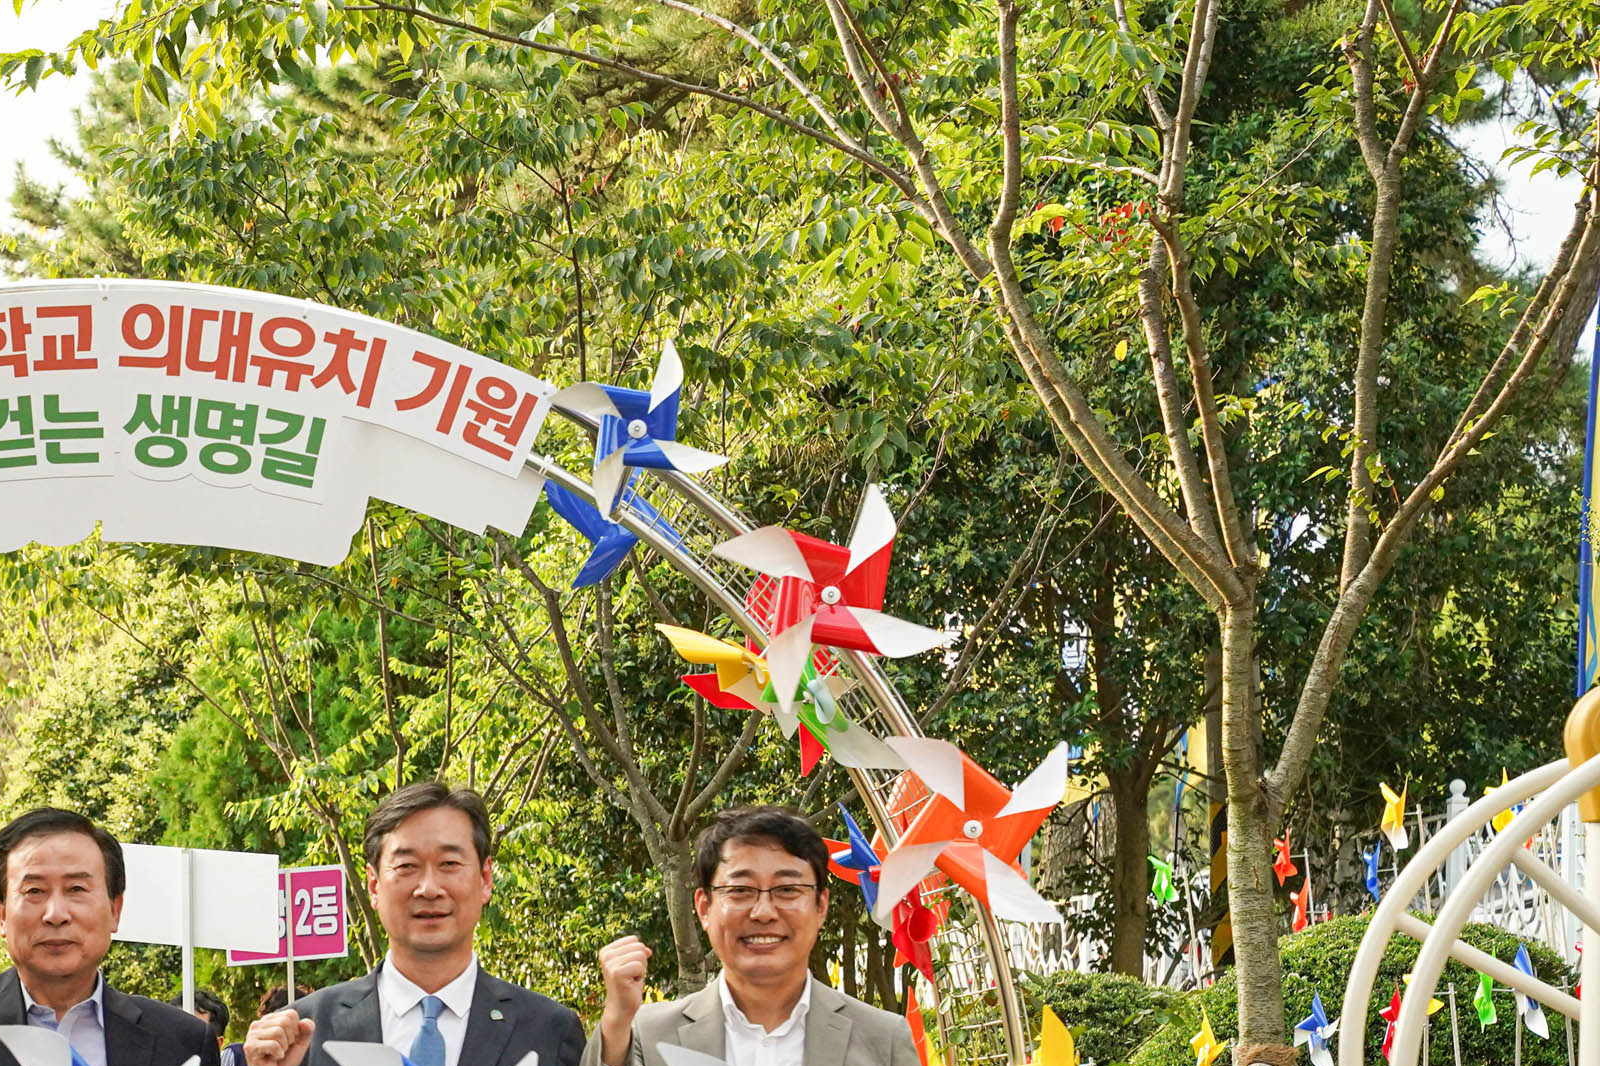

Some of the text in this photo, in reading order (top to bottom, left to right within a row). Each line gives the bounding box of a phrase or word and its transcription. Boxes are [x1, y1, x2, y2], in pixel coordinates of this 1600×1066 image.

[119, 303, 387, 408] 의대유치
[395, 350, 538, 461] 기원
[123, 394, 325, 488] 생명길
